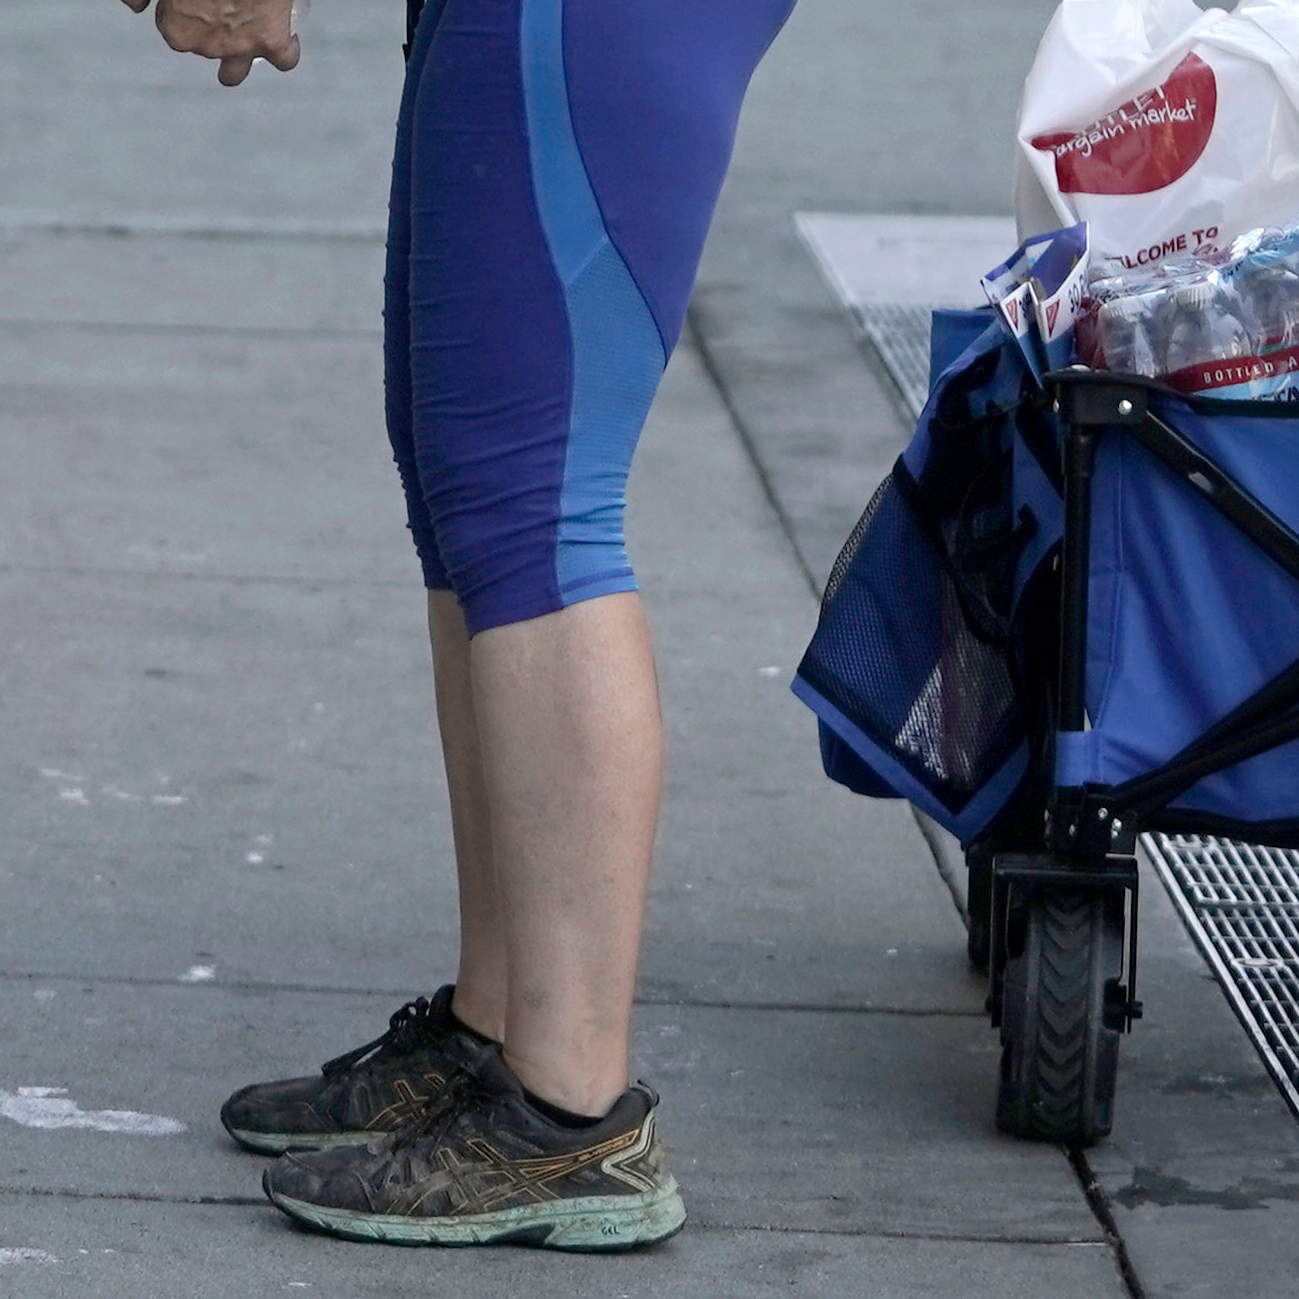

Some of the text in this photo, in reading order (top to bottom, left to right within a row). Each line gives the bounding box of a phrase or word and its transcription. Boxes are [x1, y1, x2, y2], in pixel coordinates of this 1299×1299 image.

[1051, 98, 1198, 158] argain market
[1105, 234, 1188, 270] LCOME
[1192, 225, 1219, 246] TO
[1203, 361, 1275, 385] BOTTLED
